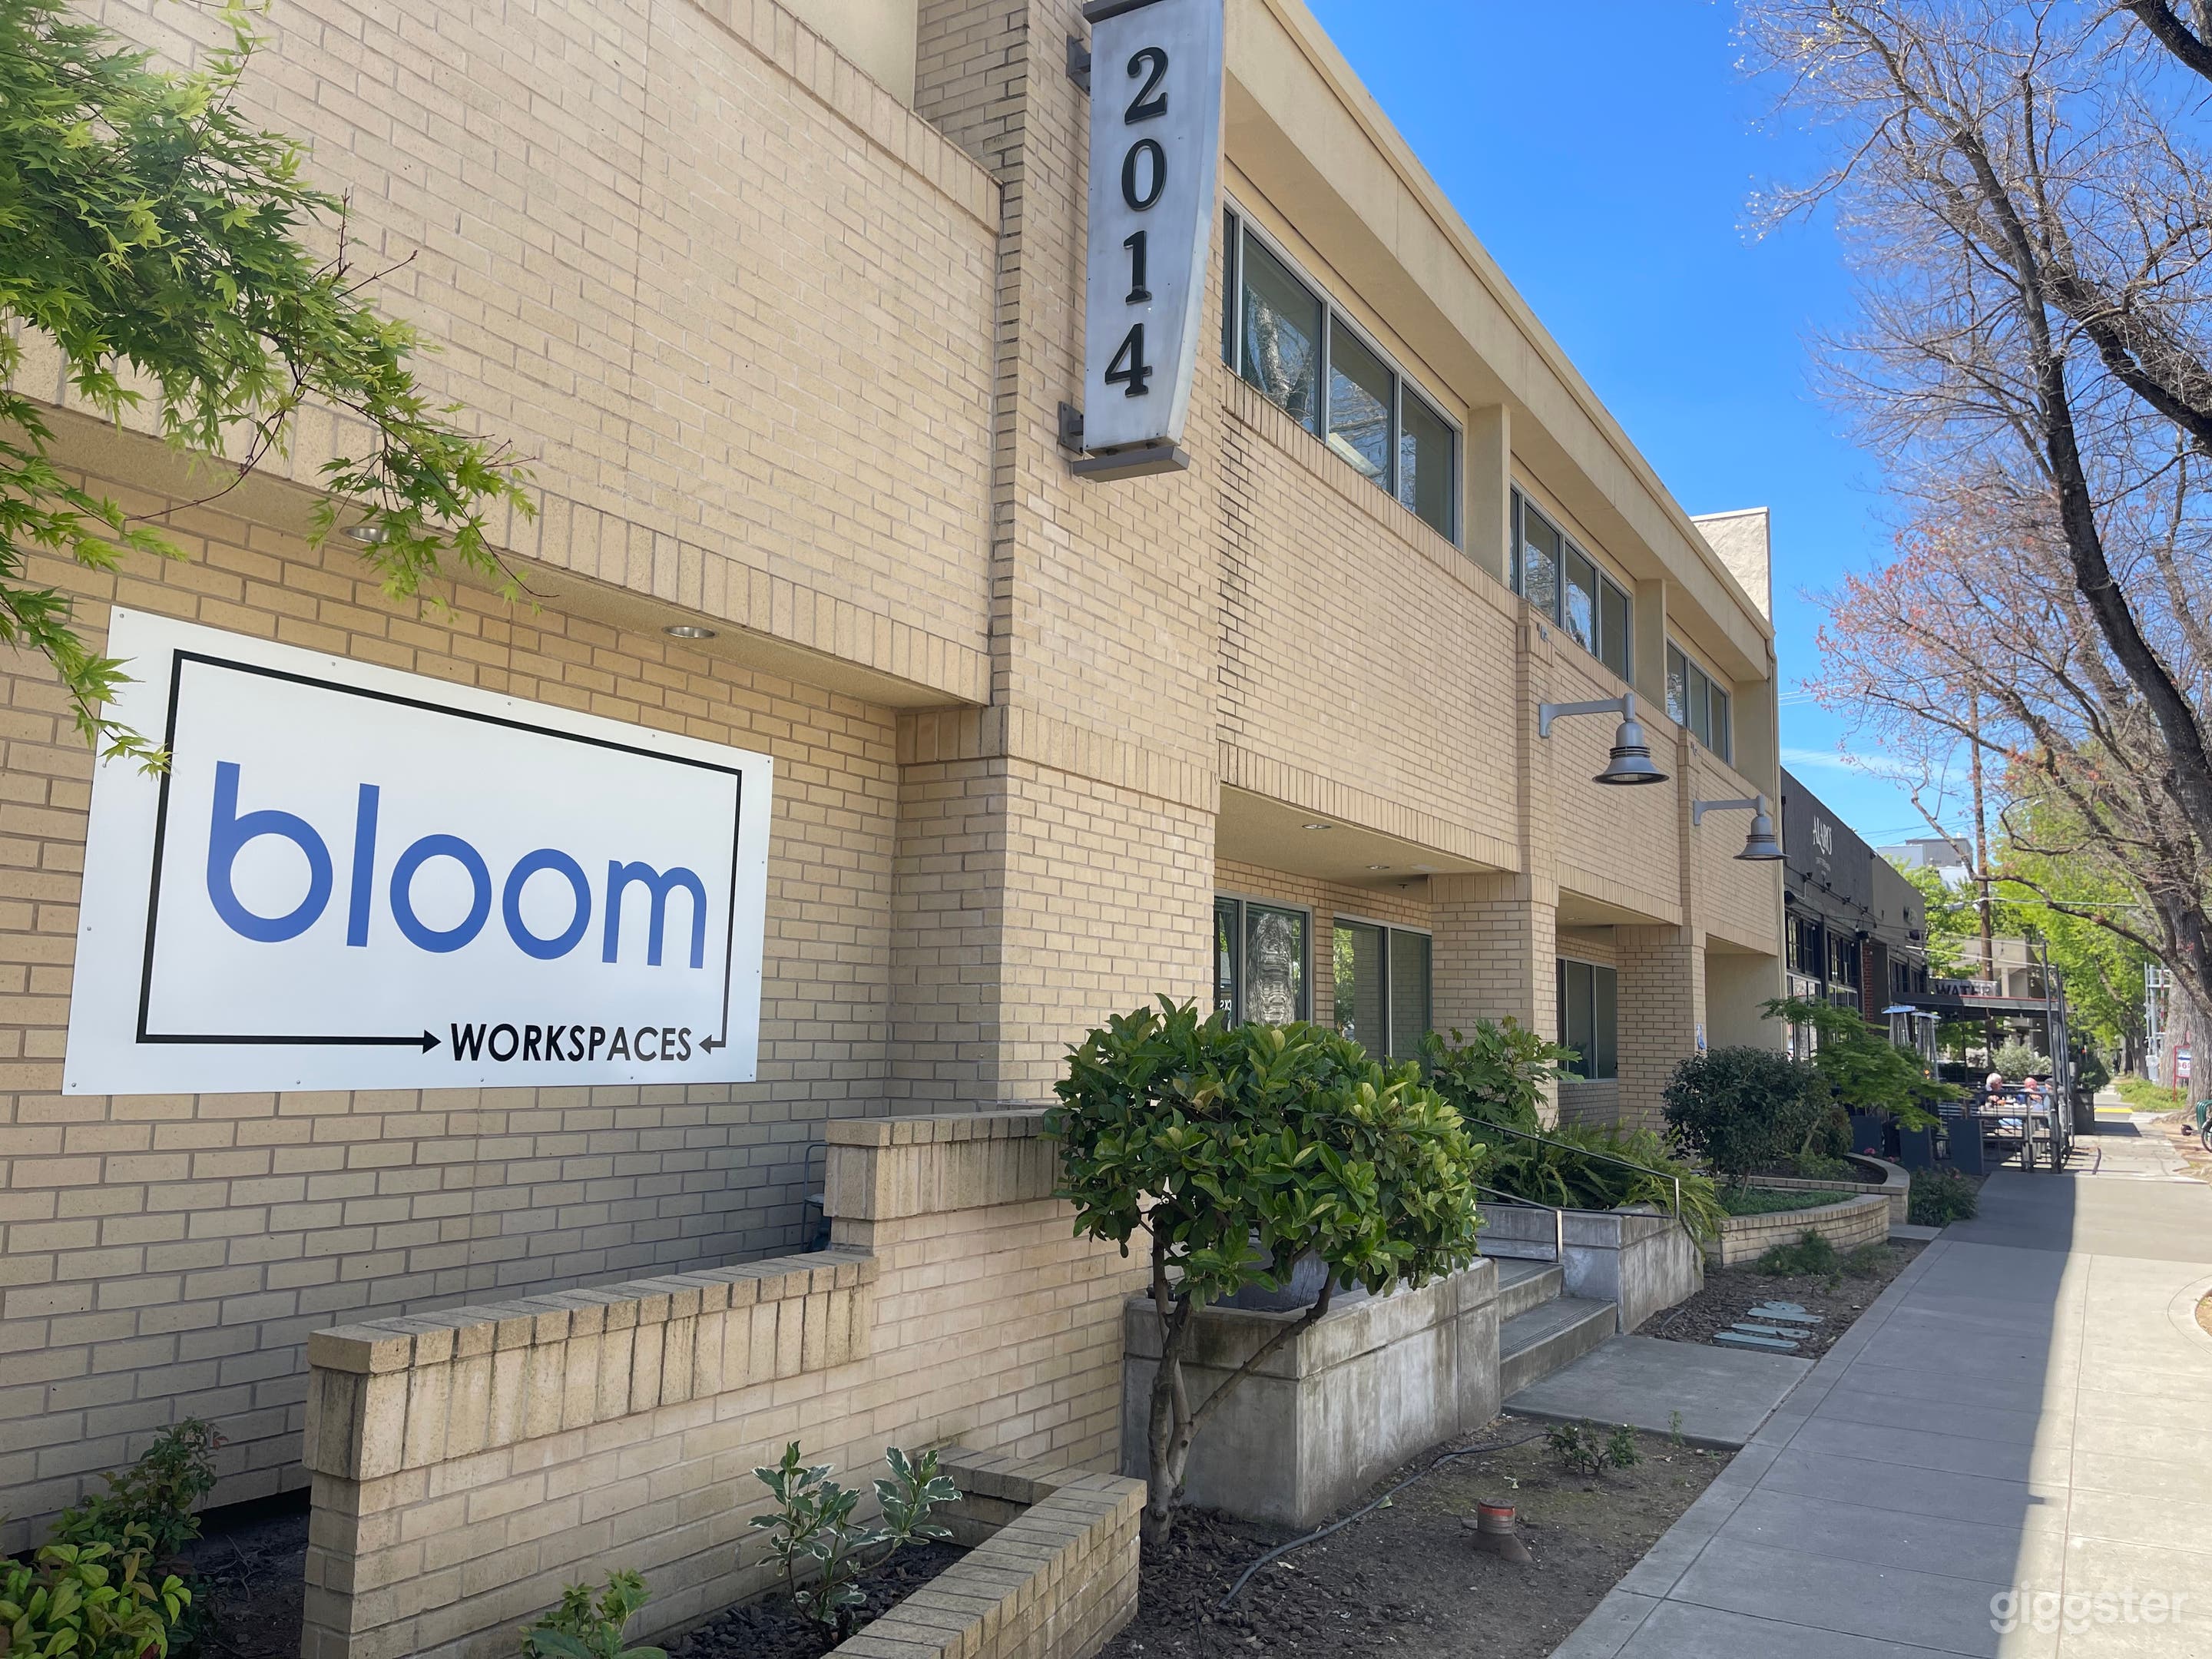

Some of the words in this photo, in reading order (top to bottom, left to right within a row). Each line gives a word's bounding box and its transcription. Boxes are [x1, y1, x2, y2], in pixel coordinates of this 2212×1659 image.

[1104, 46, 1168, 398] 2014
[206, 760, 707, 970] bloom
[450, 1022, 693, 1062] WORKSPACES
